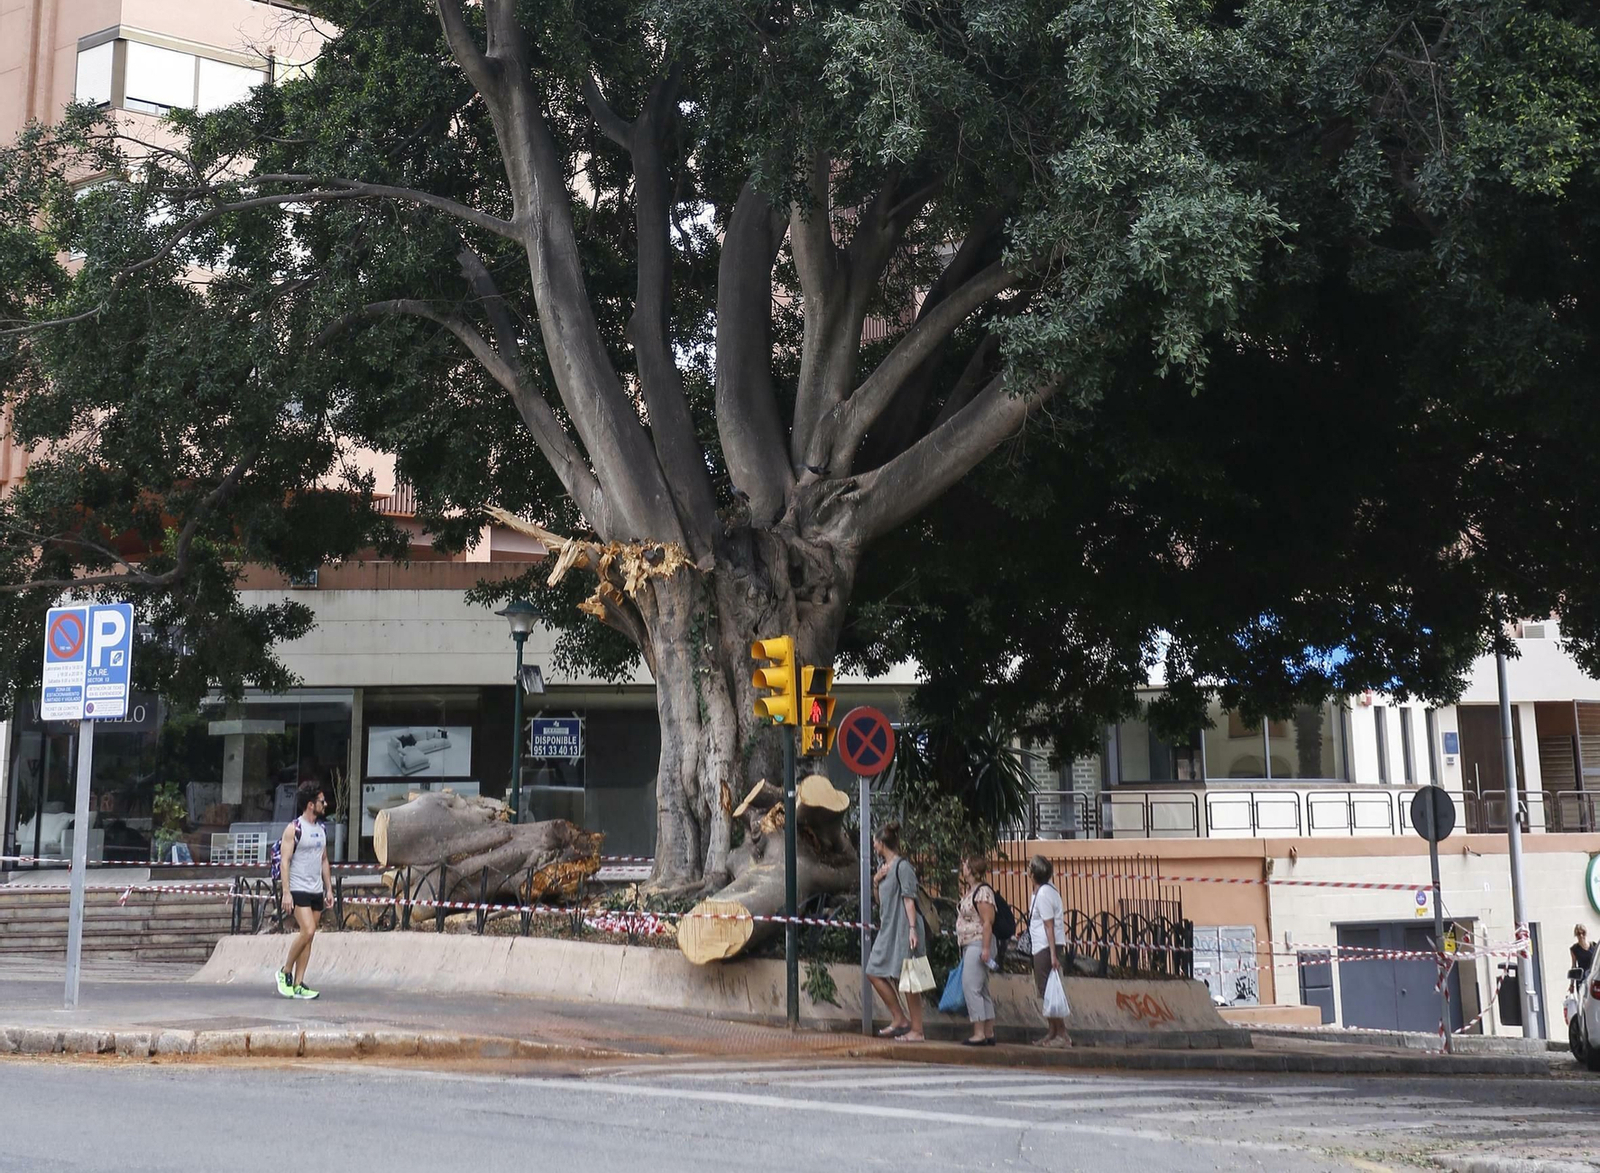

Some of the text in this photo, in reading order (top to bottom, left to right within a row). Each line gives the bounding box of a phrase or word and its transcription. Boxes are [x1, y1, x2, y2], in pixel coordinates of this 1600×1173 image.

[91, 610, 126, 668] P
[535, 735, 577, 745] DISPONIBLE
[533, 745, 578, 755] 951 33 40 13
